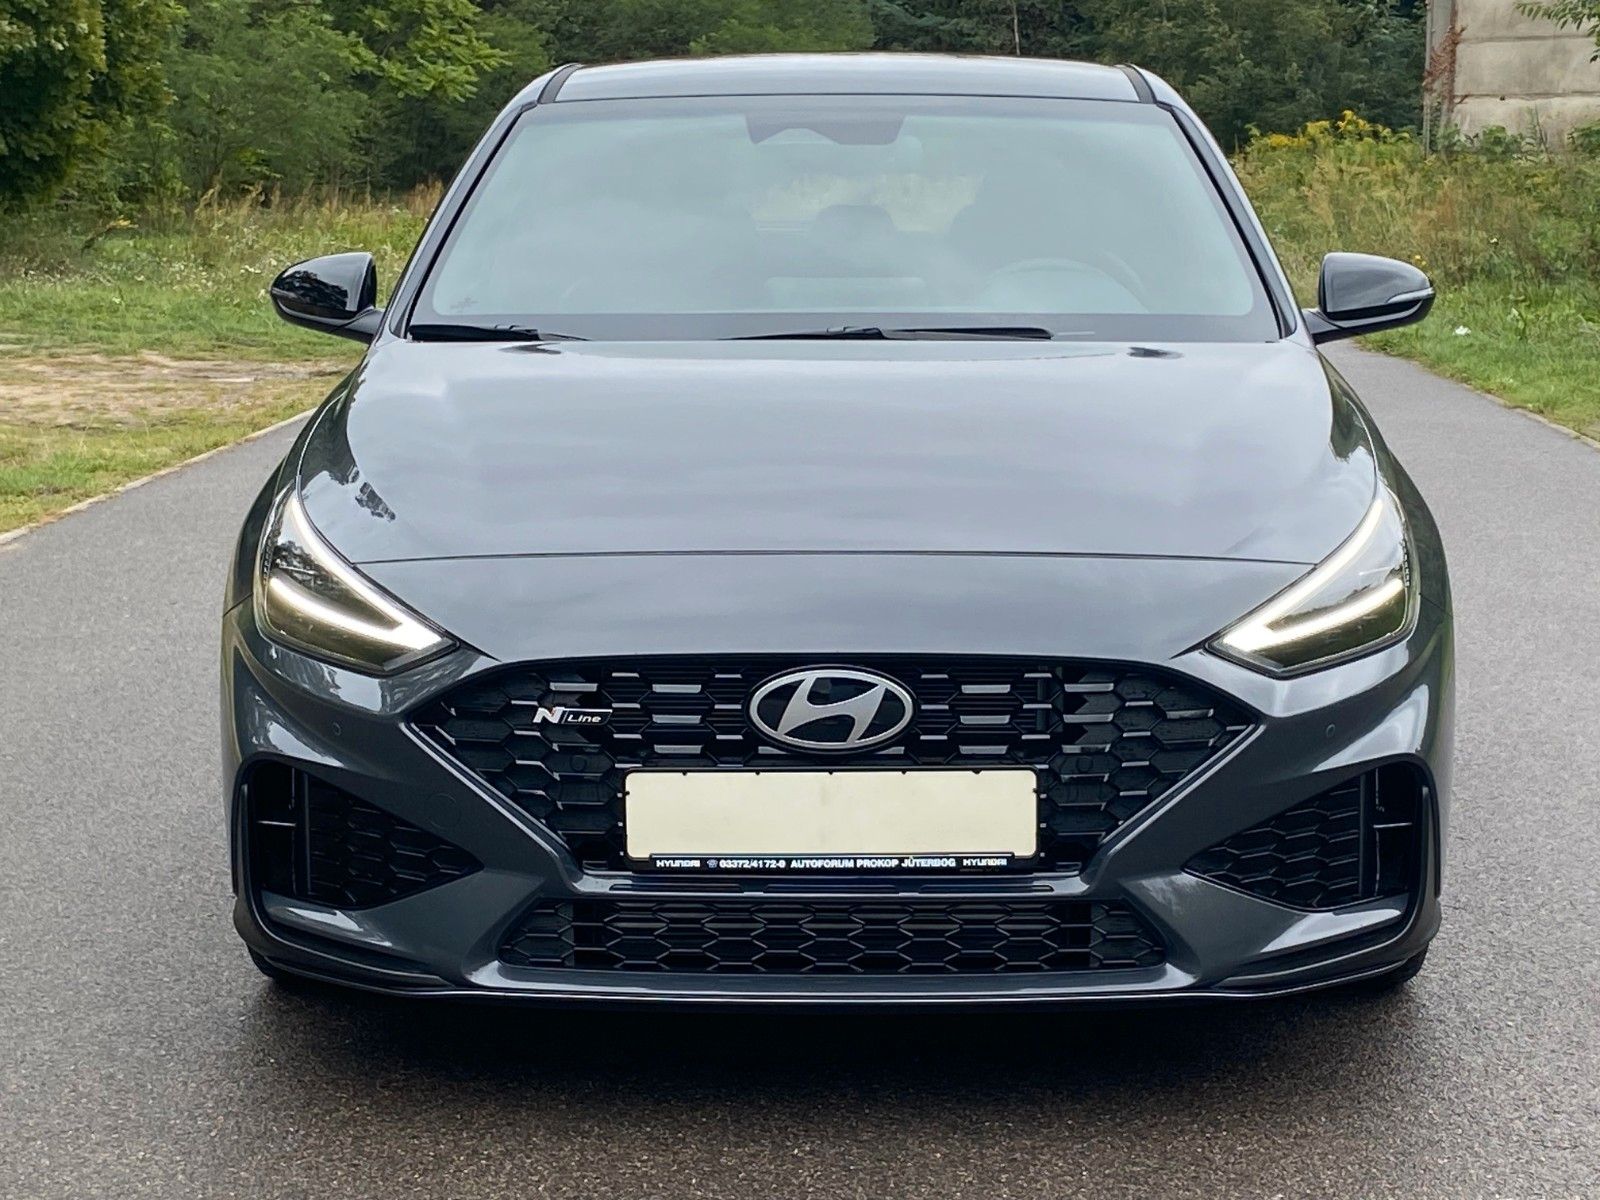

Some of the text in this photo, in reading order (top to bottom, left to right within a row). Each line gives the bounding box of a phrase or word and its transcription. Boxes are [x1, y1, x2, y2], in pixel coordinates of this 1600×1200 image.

[567, 714, 602, 723] Line
[656, 859, 701, 868] HYUNDAI
[790, 859, 854, 868] AUTOFORUM
[856, 858, 899, 868] PROKOP
[962, 858, 1008, 866] HYUNDAI
